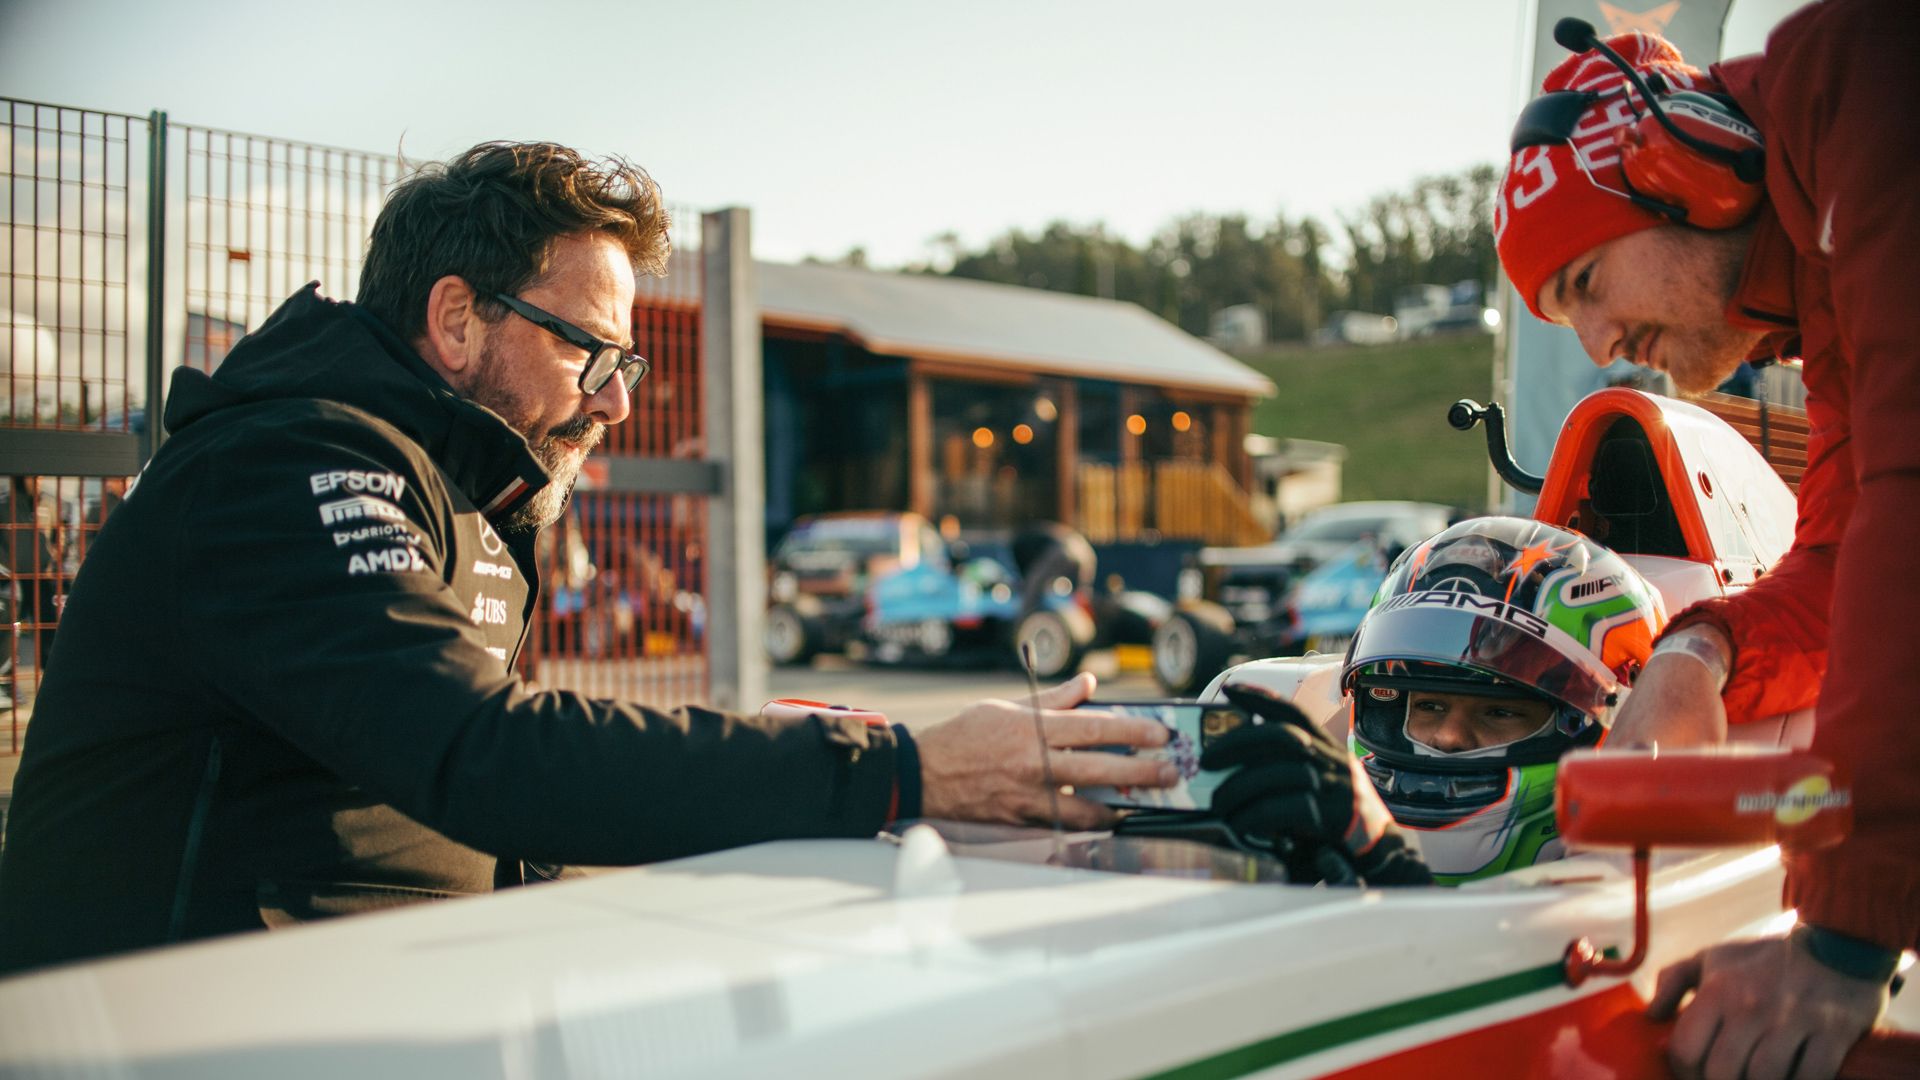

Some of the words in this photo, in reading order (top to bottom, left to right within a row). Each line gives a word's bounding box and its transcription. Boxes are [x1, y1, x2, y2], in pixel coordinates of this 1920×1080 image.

[310, 471, 405, 502] EPSON
[485, 598, 507, 624] UBS
[1373, 688, 1395, 697] BELL
